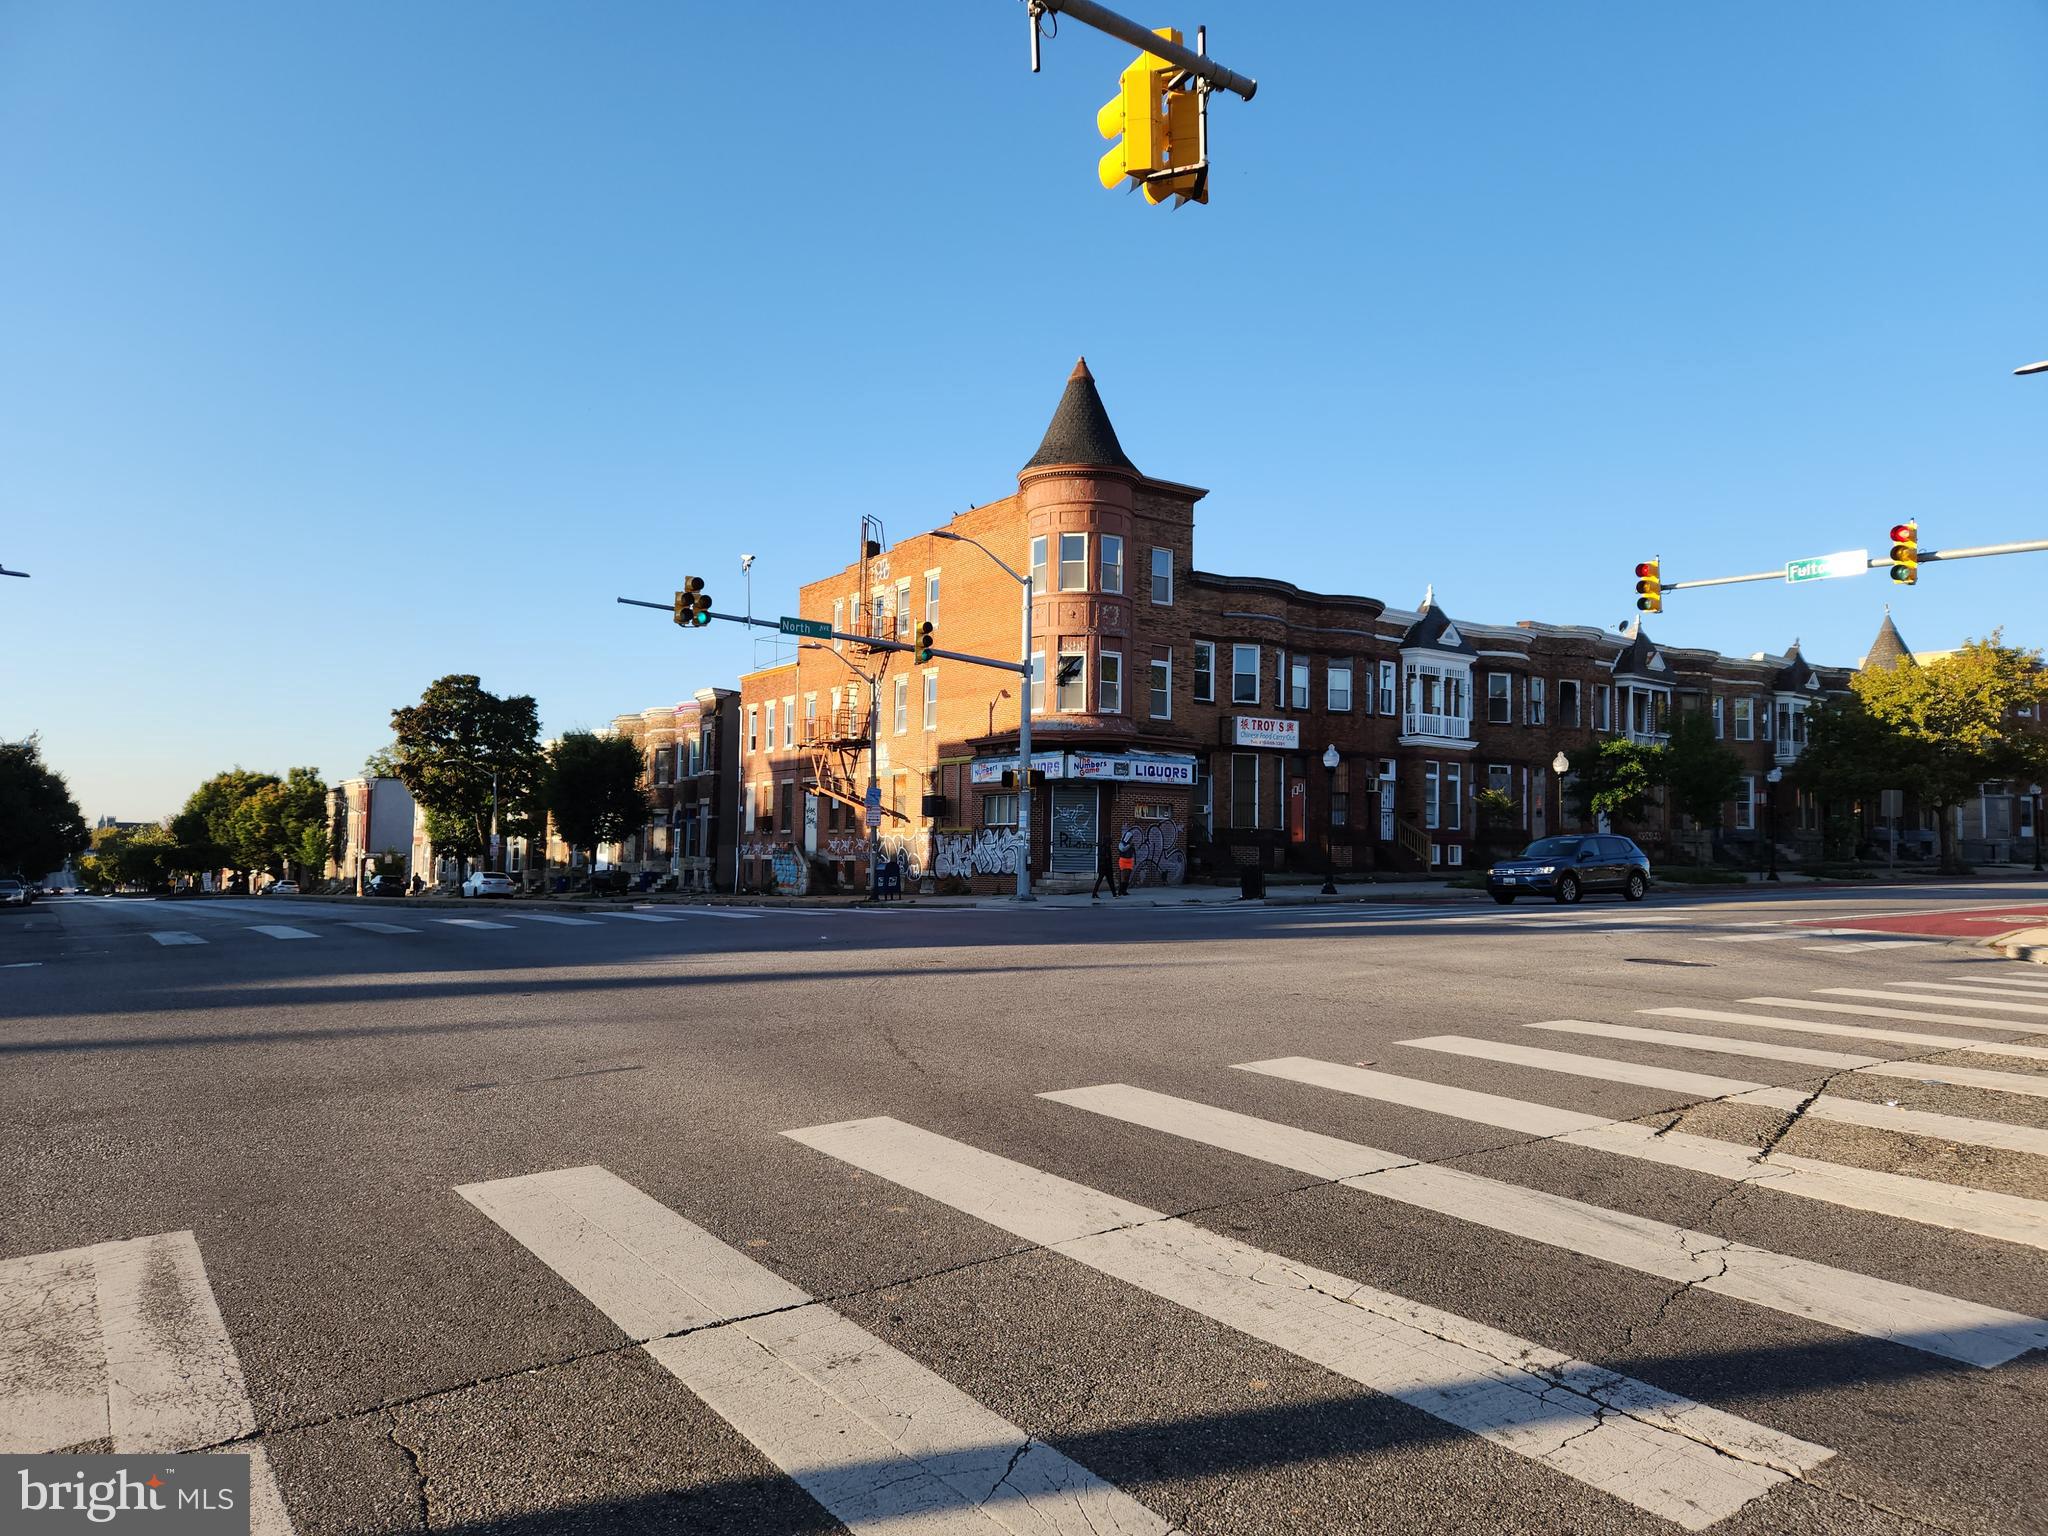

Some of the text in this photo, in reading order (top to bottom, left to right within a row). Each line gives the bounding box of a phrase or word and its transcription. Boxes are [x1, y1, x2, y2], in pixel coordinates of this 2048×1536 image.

[782, 620, 810, 634] North
[1241, 731, 1259, 739] Chinese
[1260, 732, 1272, 740] Food
[1273, 733, 1286, 742] Carry
[1073, 761, 1107, 770] Numbers
[1079, 767, 1100, 776] Game
[1135, 764, 1188, 779] LIQUORS
